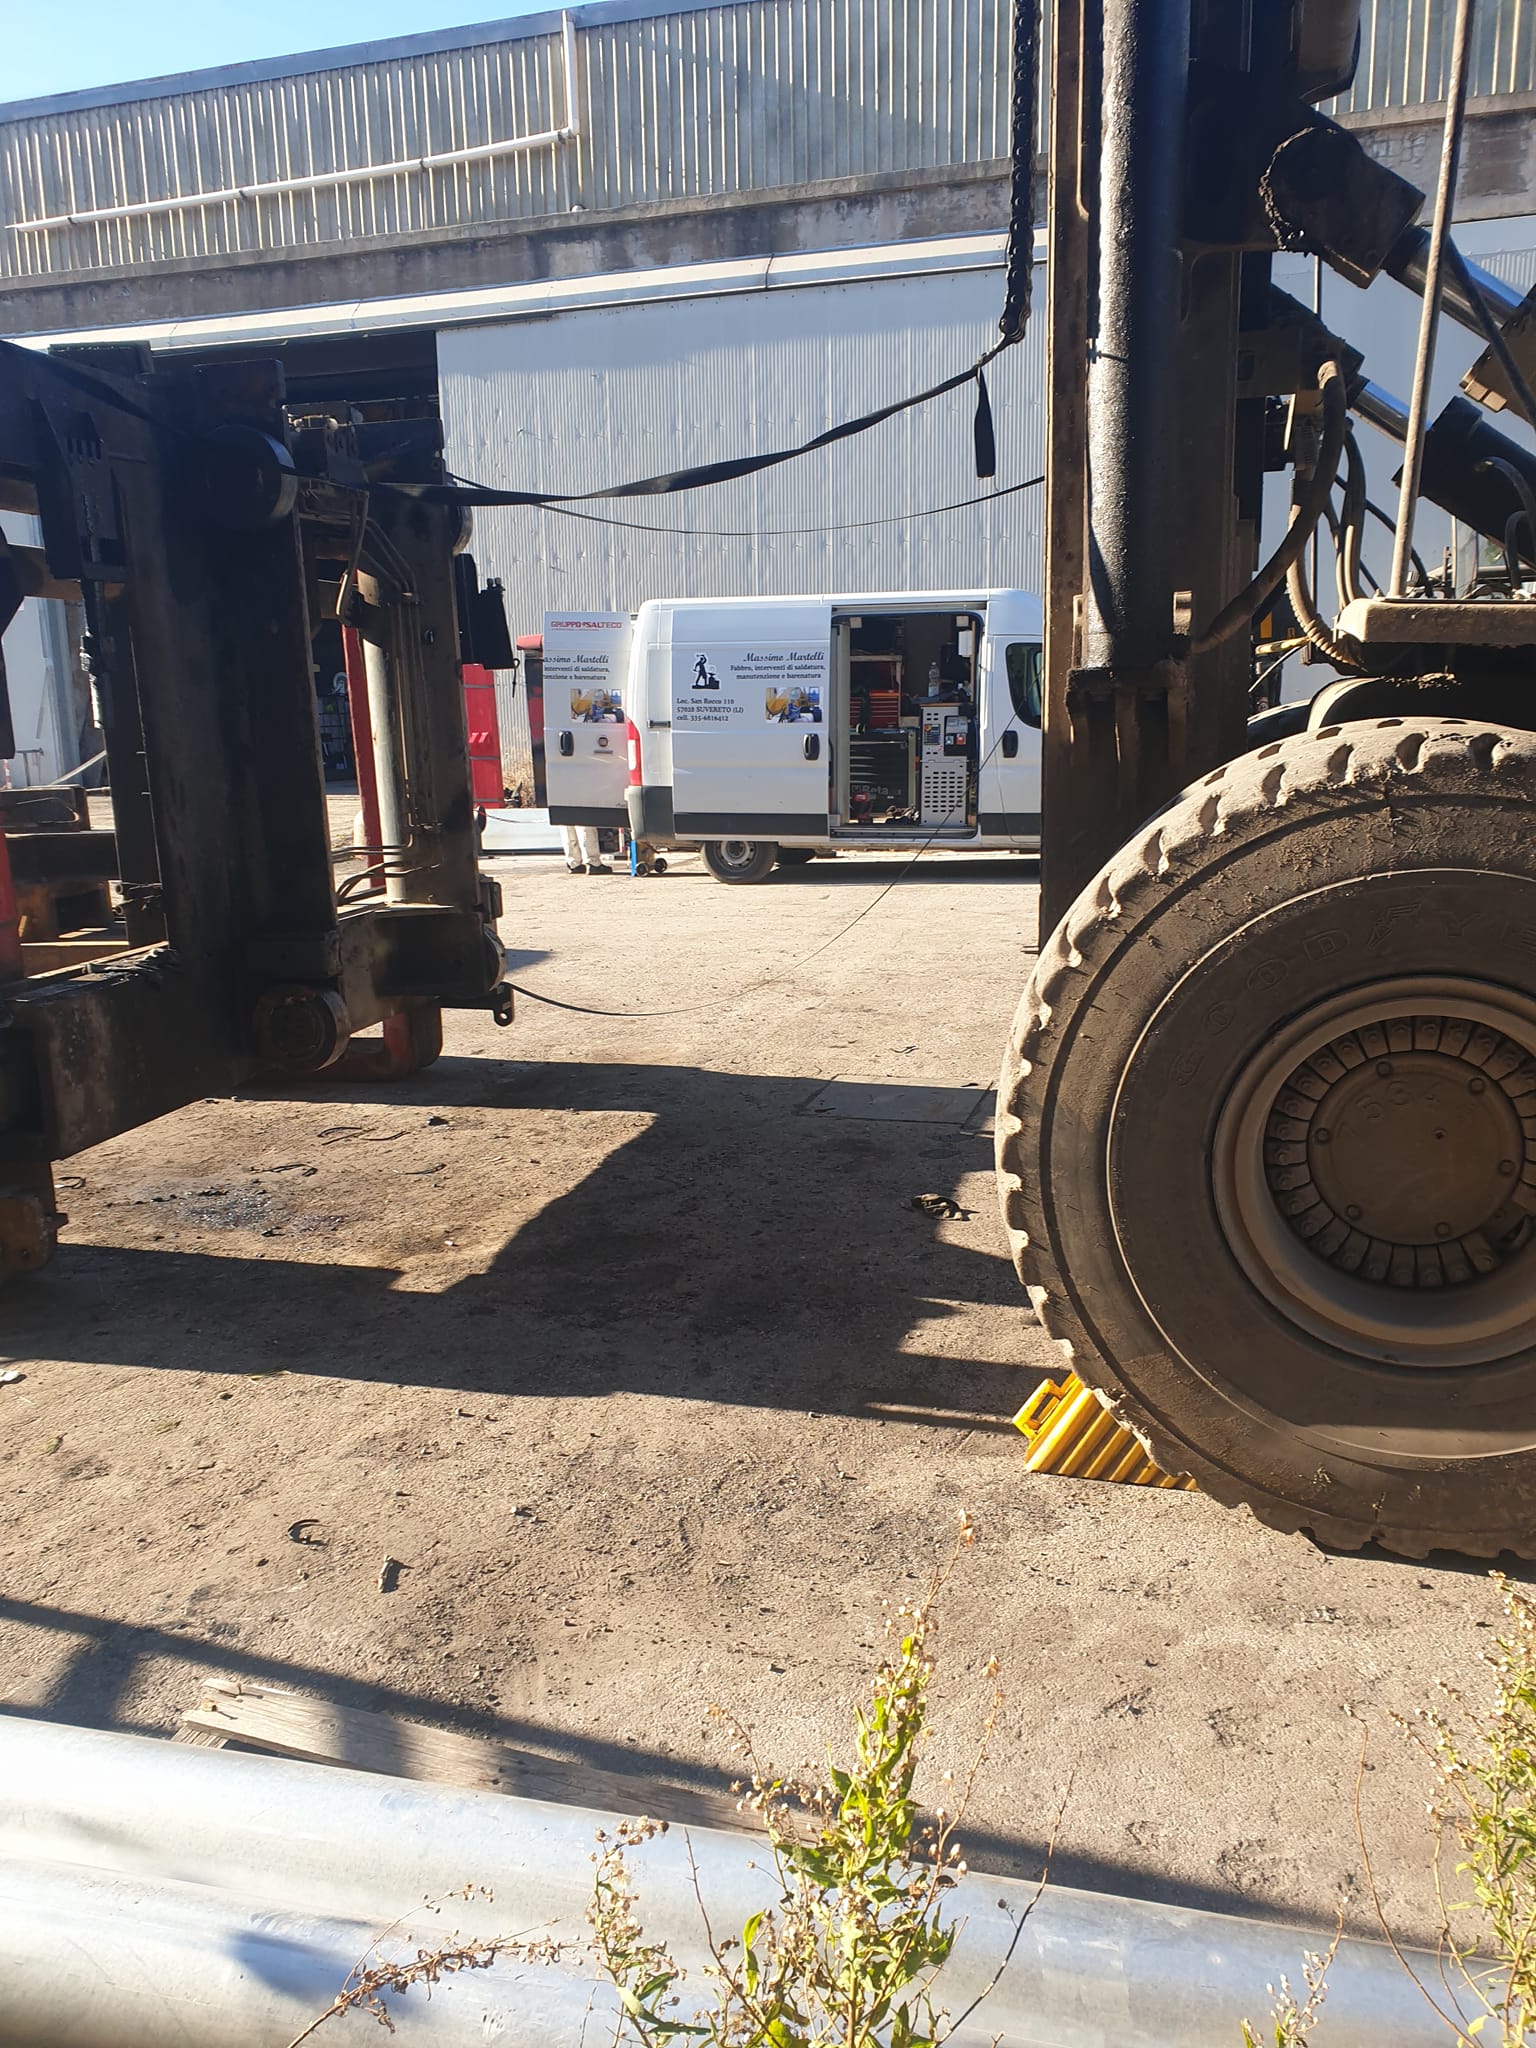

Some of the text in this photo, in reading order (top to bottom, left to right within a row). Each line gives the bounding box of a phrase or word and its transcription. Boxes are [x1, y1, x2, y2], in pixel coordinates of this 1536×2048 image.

[586, 621, 623, 629] SALTECO
[573, 654, 609, 664] Martelli
[744, 651, 825, 662] Massimo Martelli
[730, 664, 754, 673] Fabbro,
